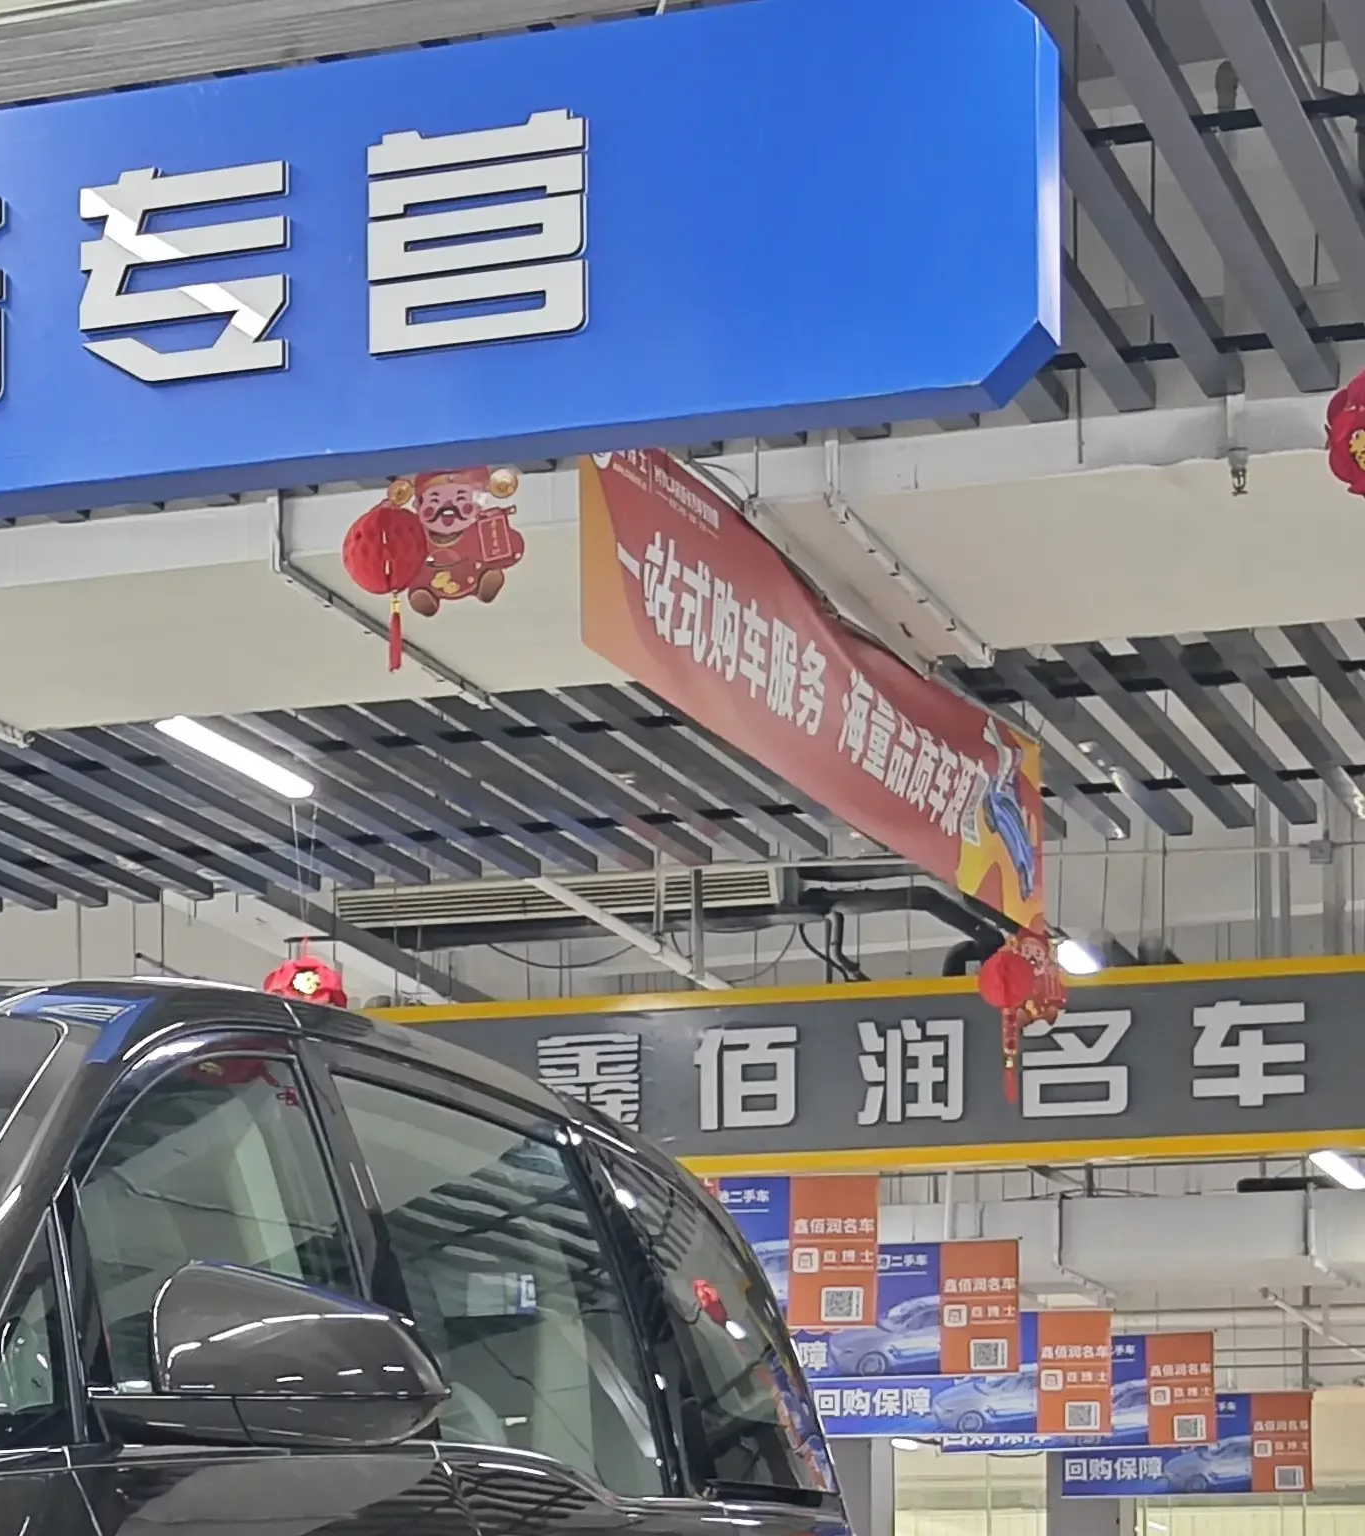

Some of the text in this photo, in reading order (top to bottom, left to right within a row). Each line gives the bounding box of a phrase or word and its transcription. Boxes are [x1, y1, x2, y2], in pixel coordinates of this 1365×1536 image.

[616, 530, 827, 737] 一站式购车服务
[537, 1000, 1306, 1134] 鑫佰润名车
[813, 1387, 932, 1417] 回购保障
[1064, 1456, 1164, 1482] 回购保障
